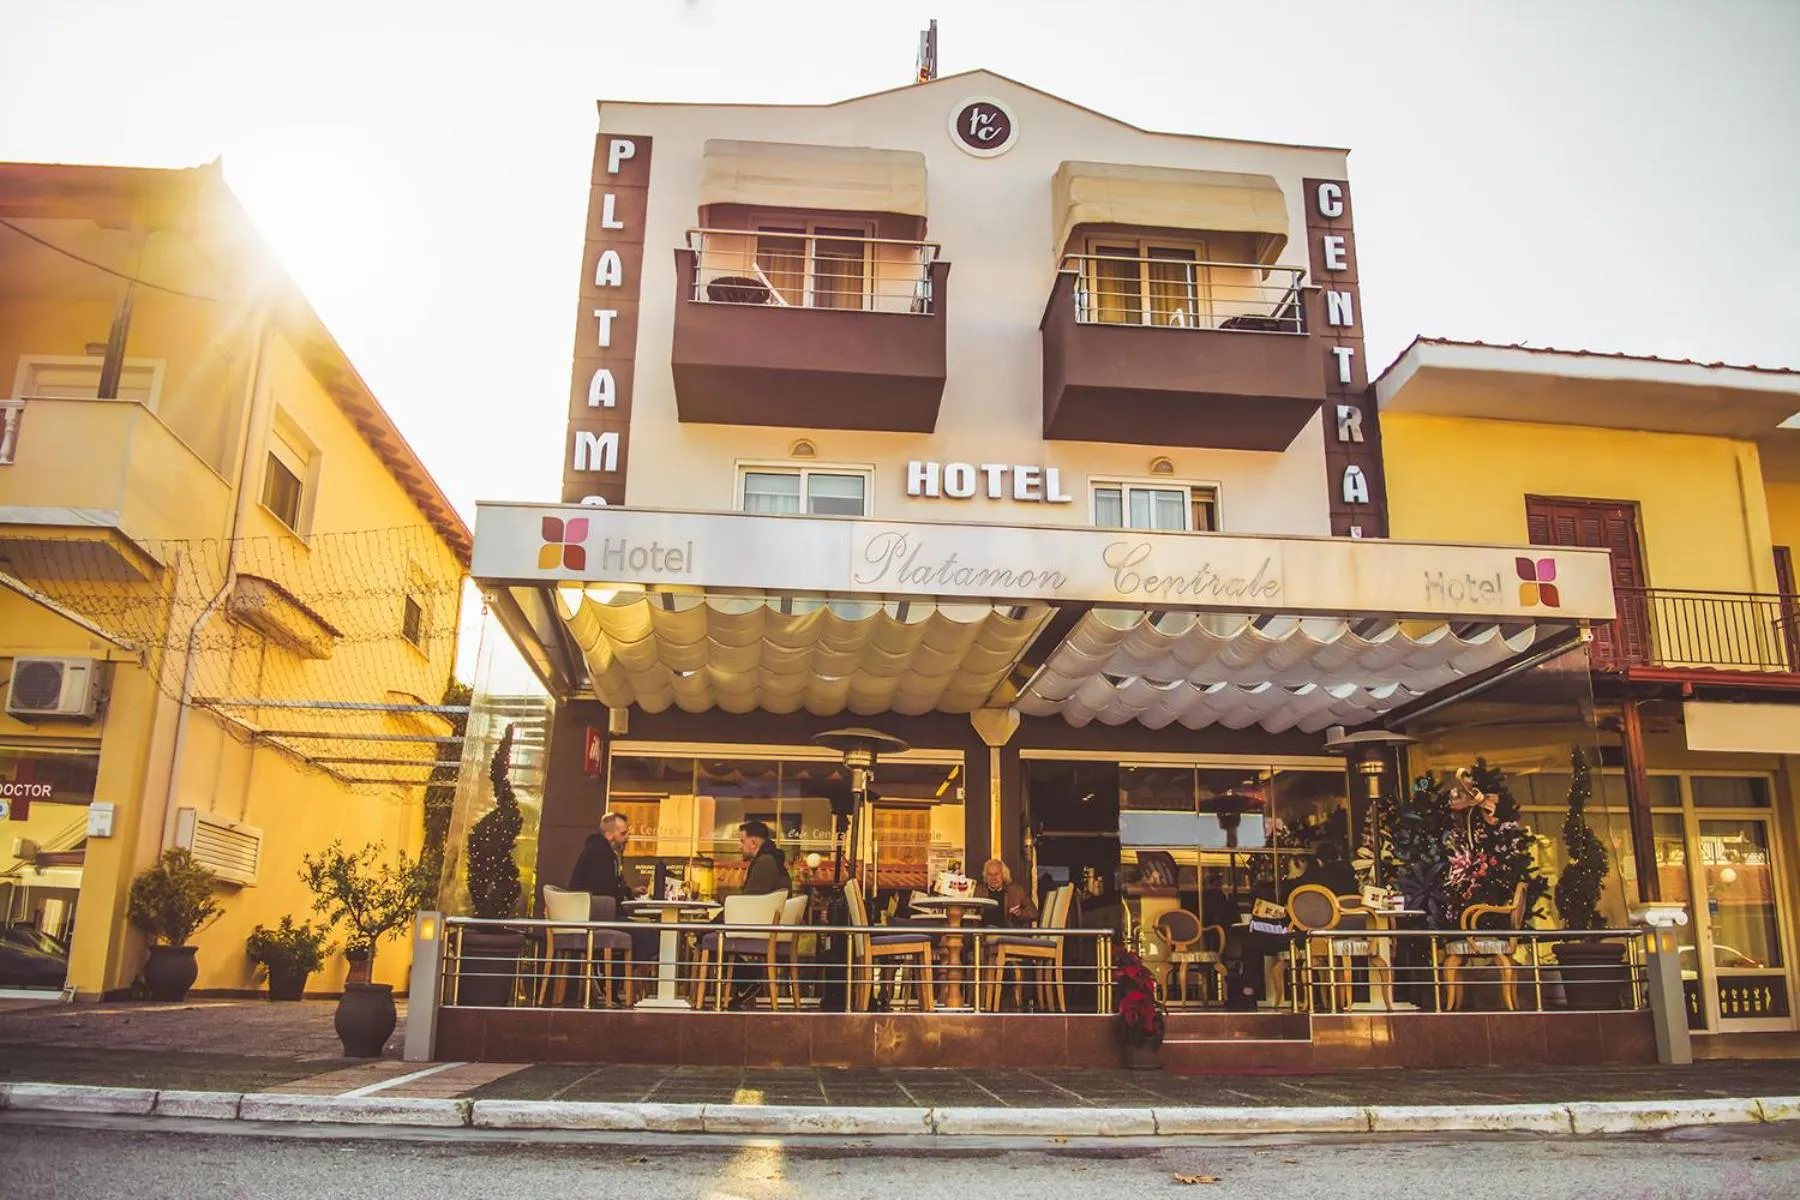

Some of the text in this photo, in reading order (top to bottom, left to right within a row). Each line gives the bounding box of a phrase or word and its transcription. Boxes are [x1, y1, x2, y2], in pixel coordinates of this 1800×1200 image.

[907, 460, 1073, 503] HOTEL
[601, 537, 694, 574] Hotel
[853, 531, 1281, 598] Platamon Centrale
[1424, 570, 1504, 606] Hotel
[0, 783, 52, 797] OCTOR
